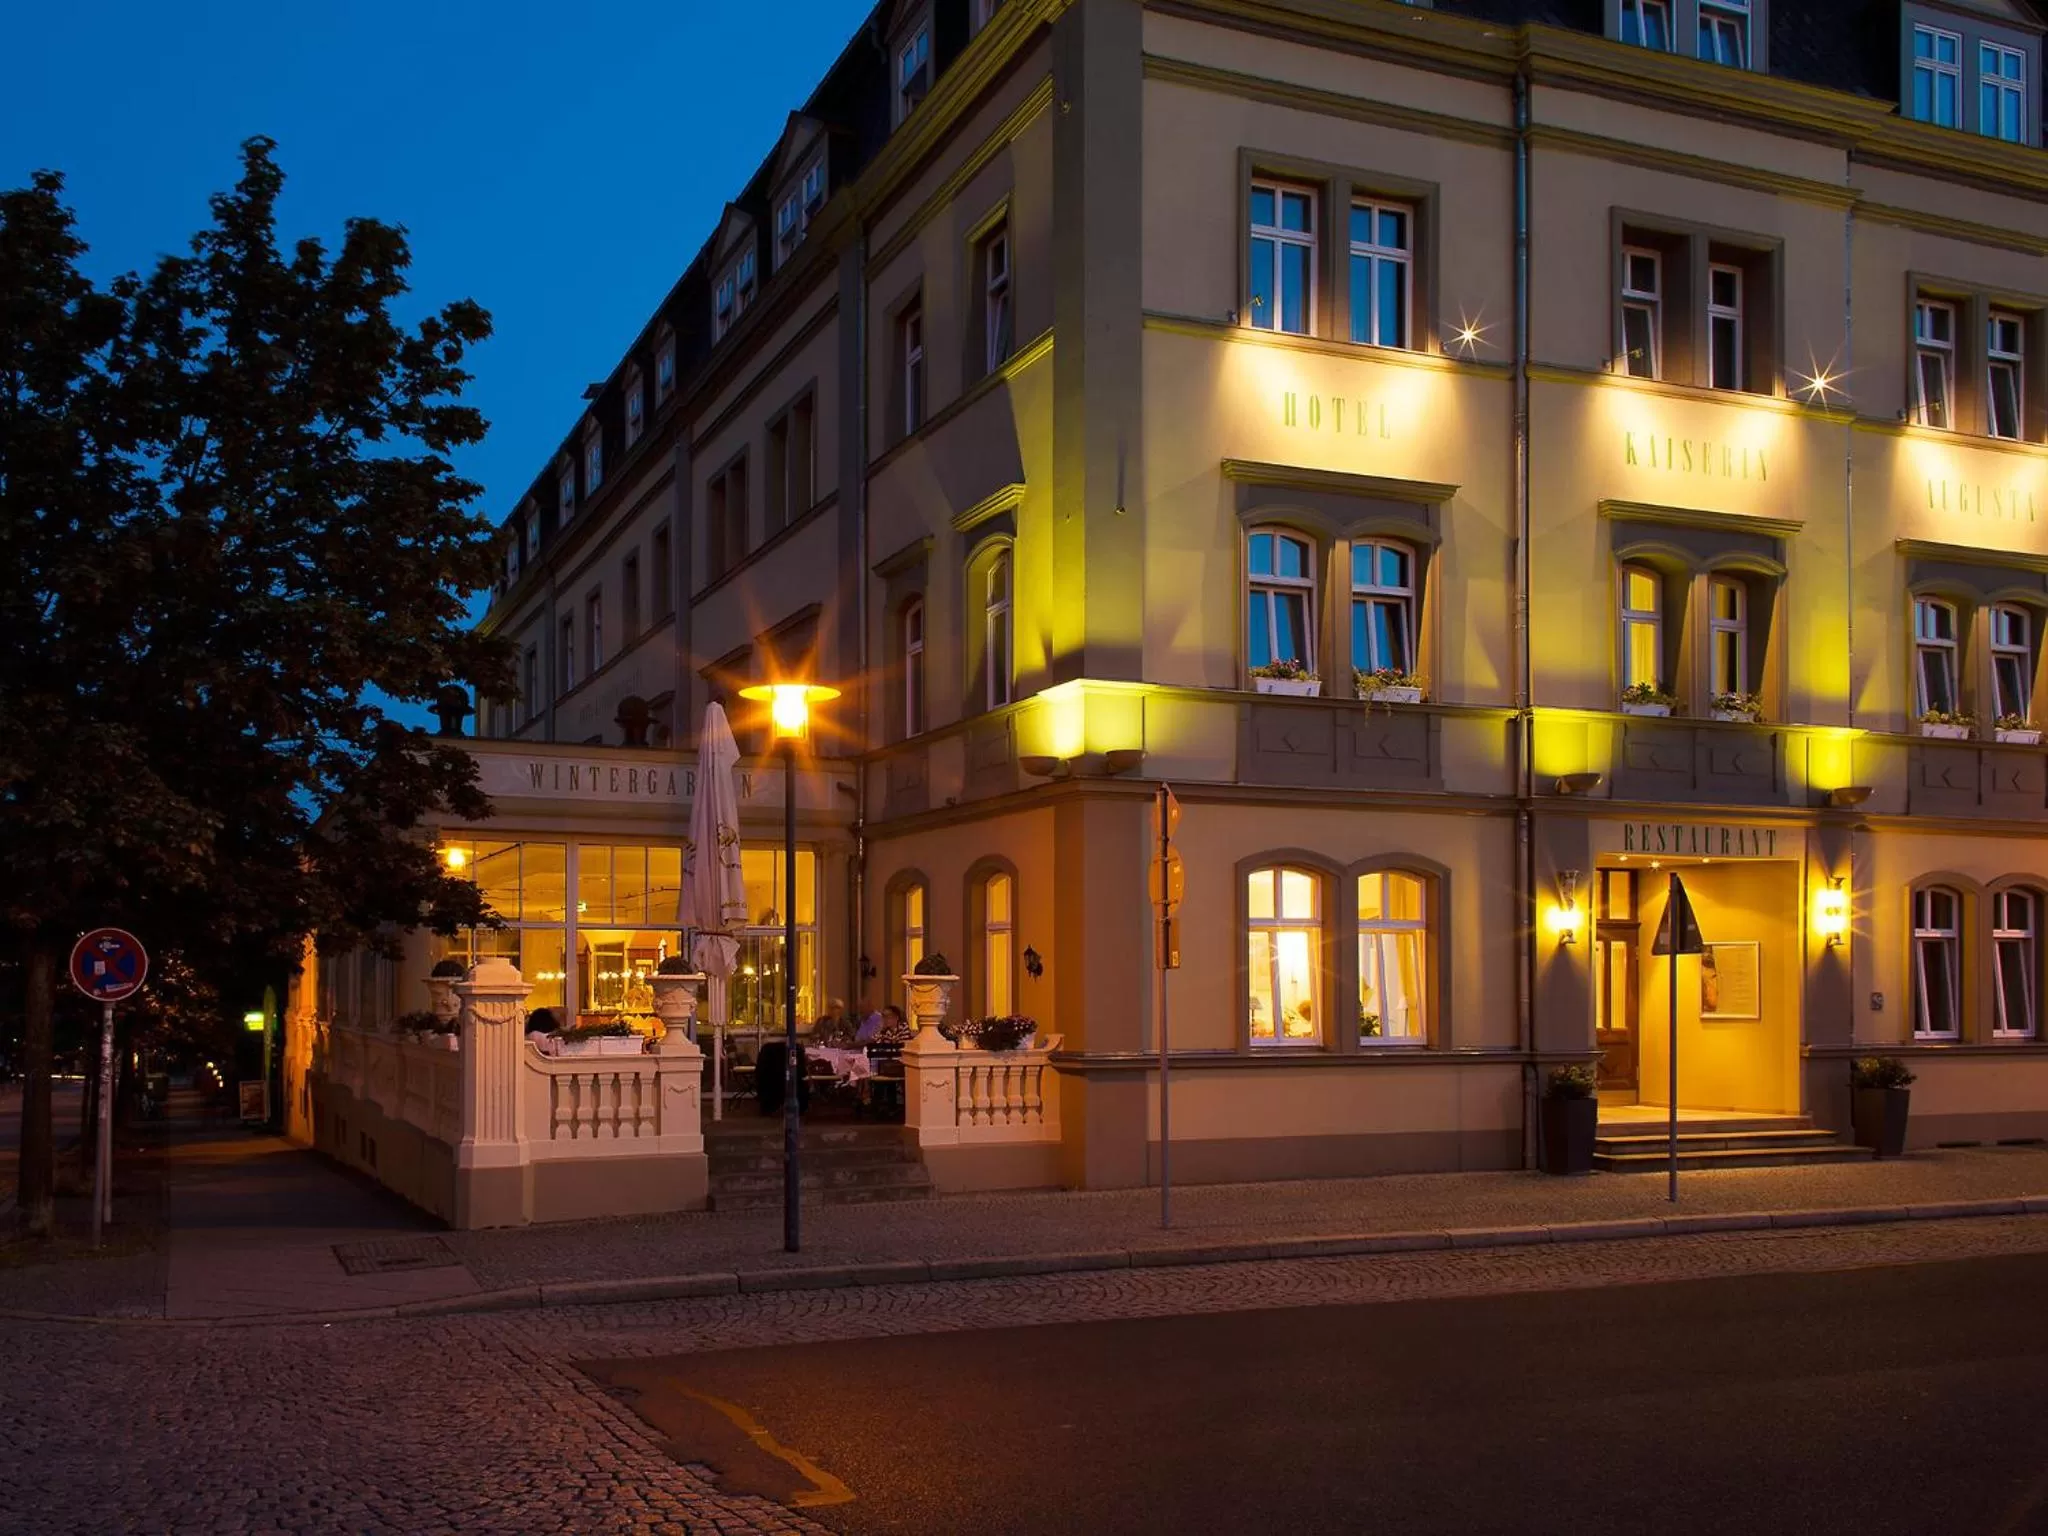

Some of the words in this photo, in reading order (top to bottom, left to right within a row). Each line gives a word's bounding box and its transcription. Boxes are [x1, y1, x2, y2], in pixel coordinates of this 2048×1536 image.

[1283, 391, 1391, 439] HOTEL
[1626, 431, 1767, 482] KAISERIN
[1925, 478, 2037, 523] AUGUSTA
[529, 763, 753, 798] WINTERGARN
[1624, 823, 1777, 857] RESTAURANT
